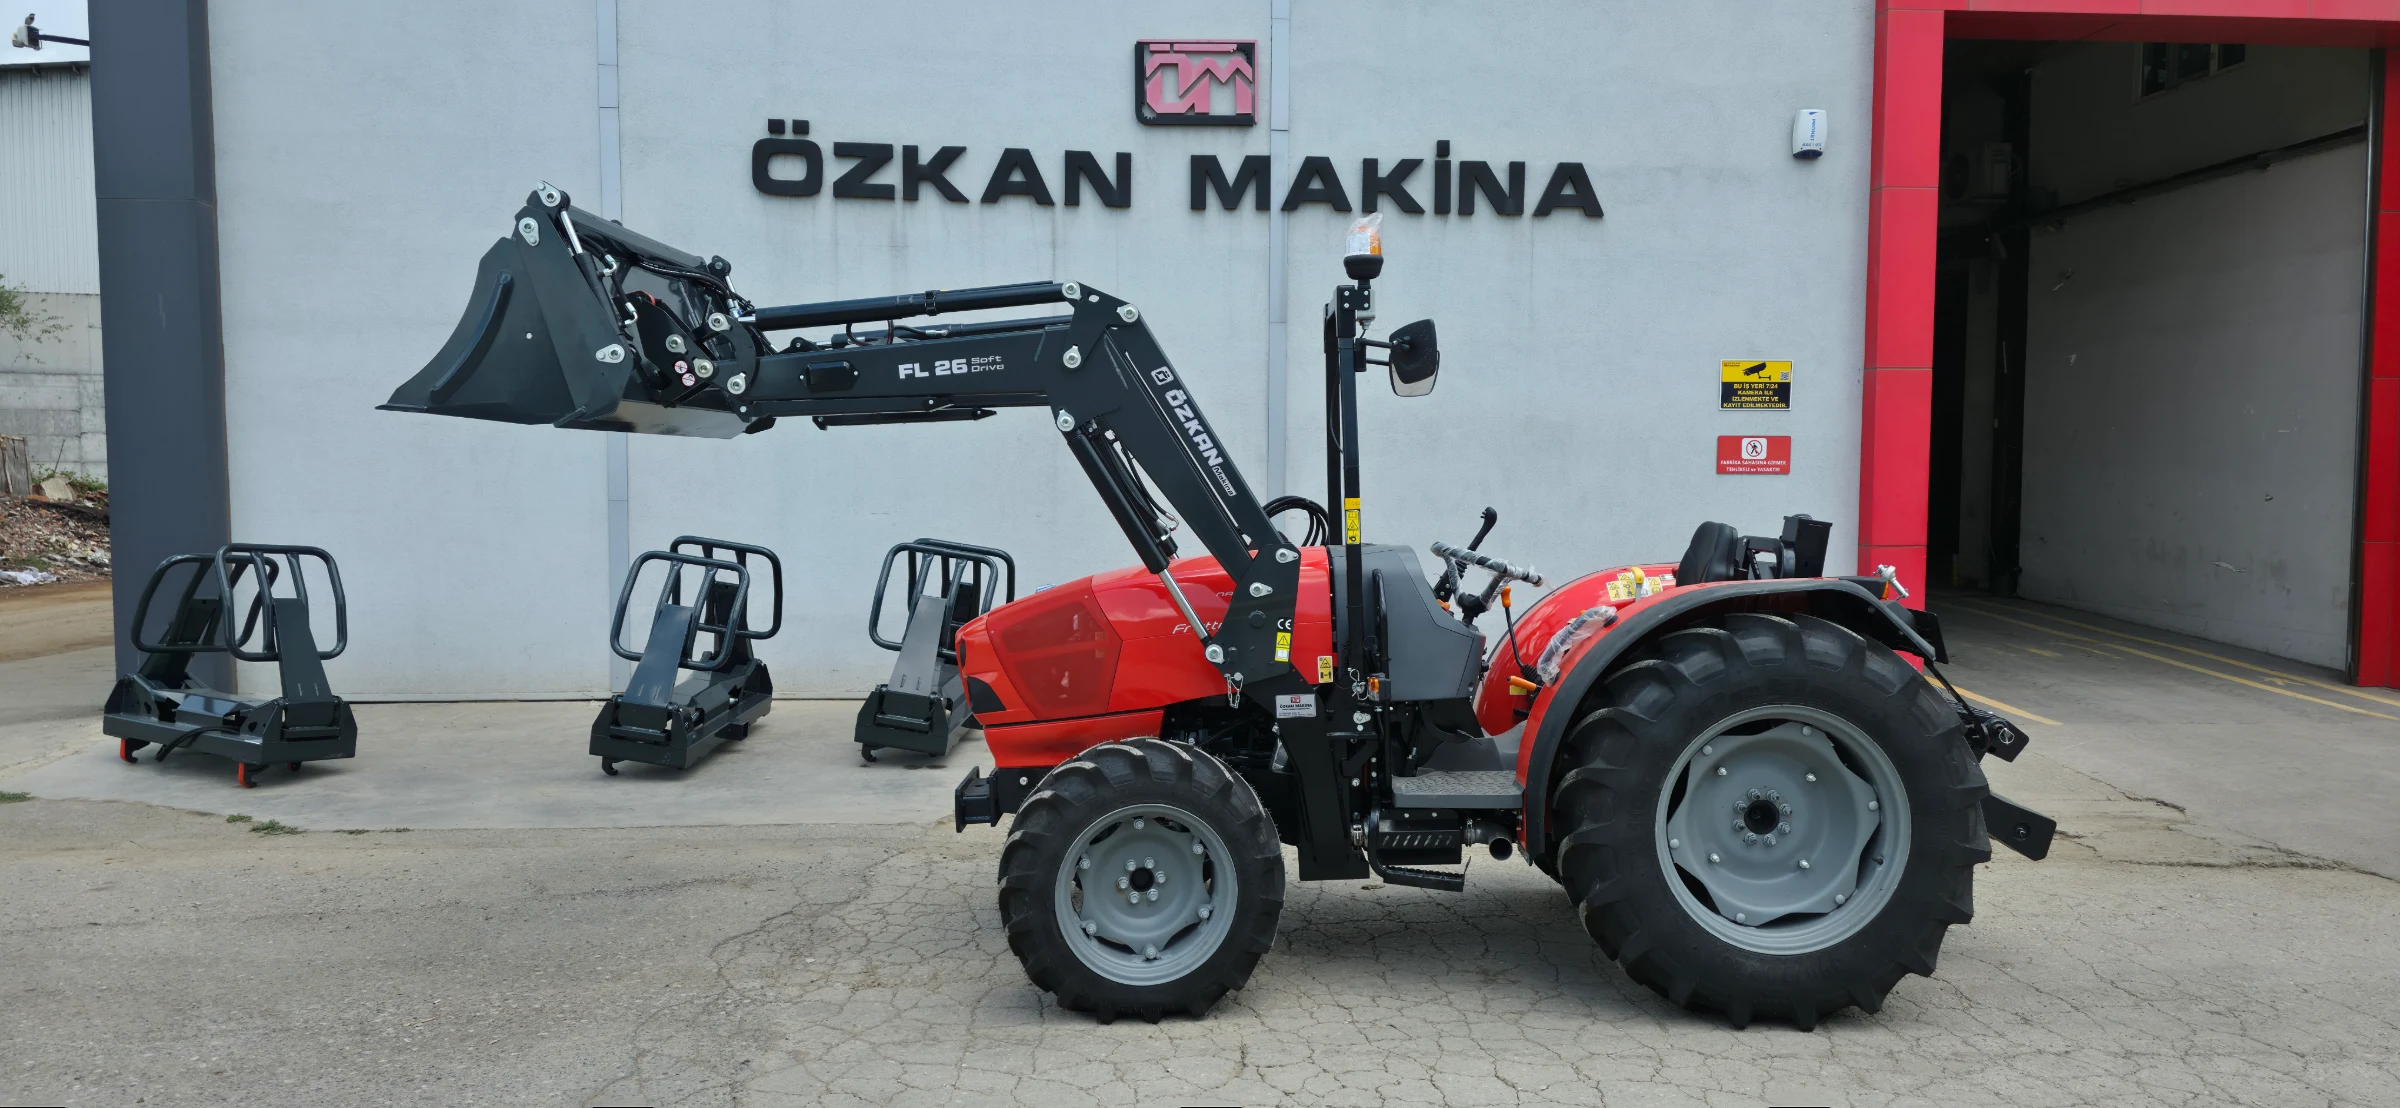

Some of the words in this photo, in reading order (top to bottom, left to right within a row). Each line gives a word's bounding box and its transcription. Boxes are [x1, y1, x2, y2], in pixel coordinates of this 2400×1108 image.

[752, 118, 1132, 208] ÖZKAN
[1190, 139, 1605, 218] MAKİNA
[898, 362, 930, 379] FL
[934, 358, 968, 376] 26
[971, 355, 1002, 364] Soft
[971, 364, 1004, 372] Drive
[1165, 389, 1223, 467] ÖZKAN
[1213, 467, 1235, 496] Makina
